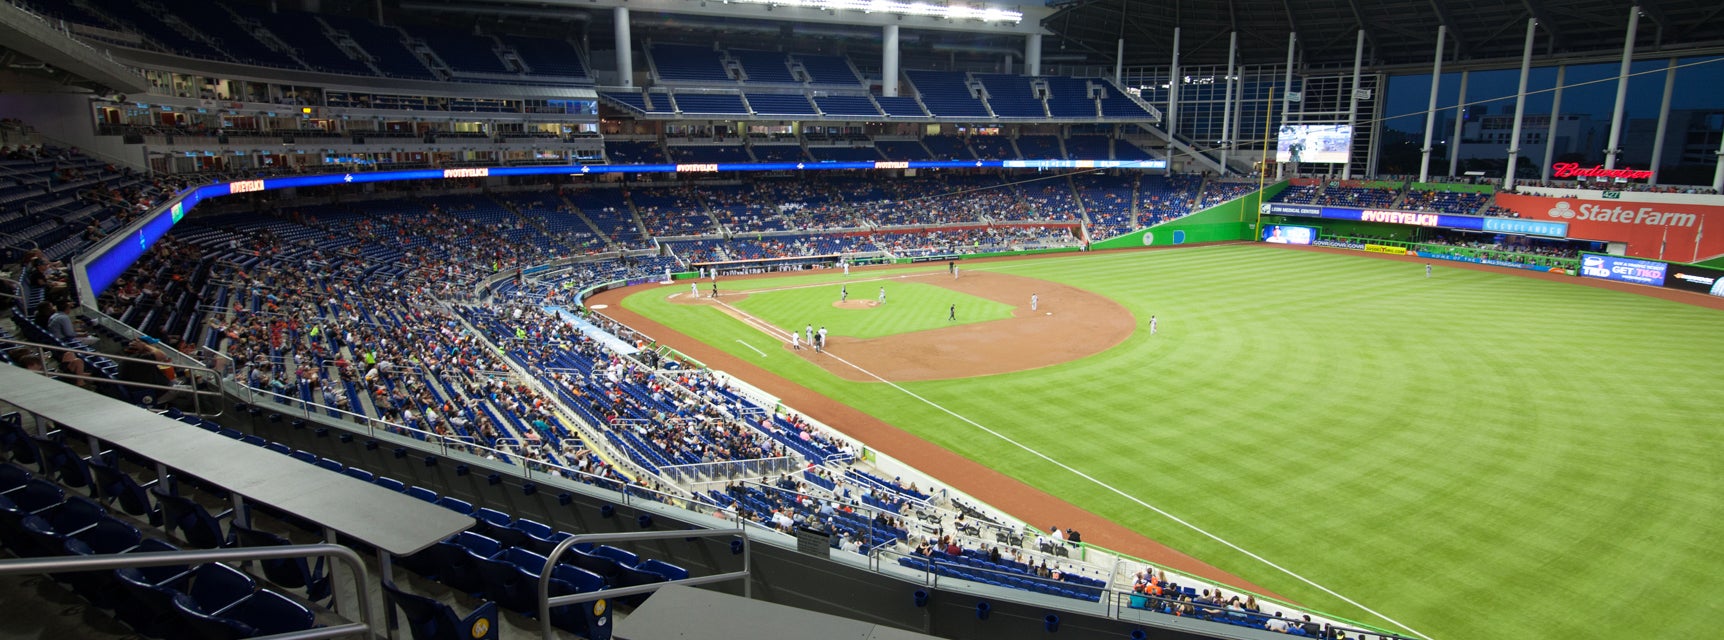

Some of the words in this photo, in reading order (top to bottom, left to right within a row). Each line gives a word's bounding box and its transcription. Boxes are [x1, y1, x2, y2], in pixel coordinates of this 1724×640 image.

[1552, 162, 1655, 179] Budweiser
[1603, 190, 1620, 199] 427
[1361, 210, 1439, 227] #VOTEYELICH
[1486, 219, 1563, 235] CLEVELANDER
[1583, 266, 1611, 278] TIKD
[1612, 266, 1634, 275] GET
